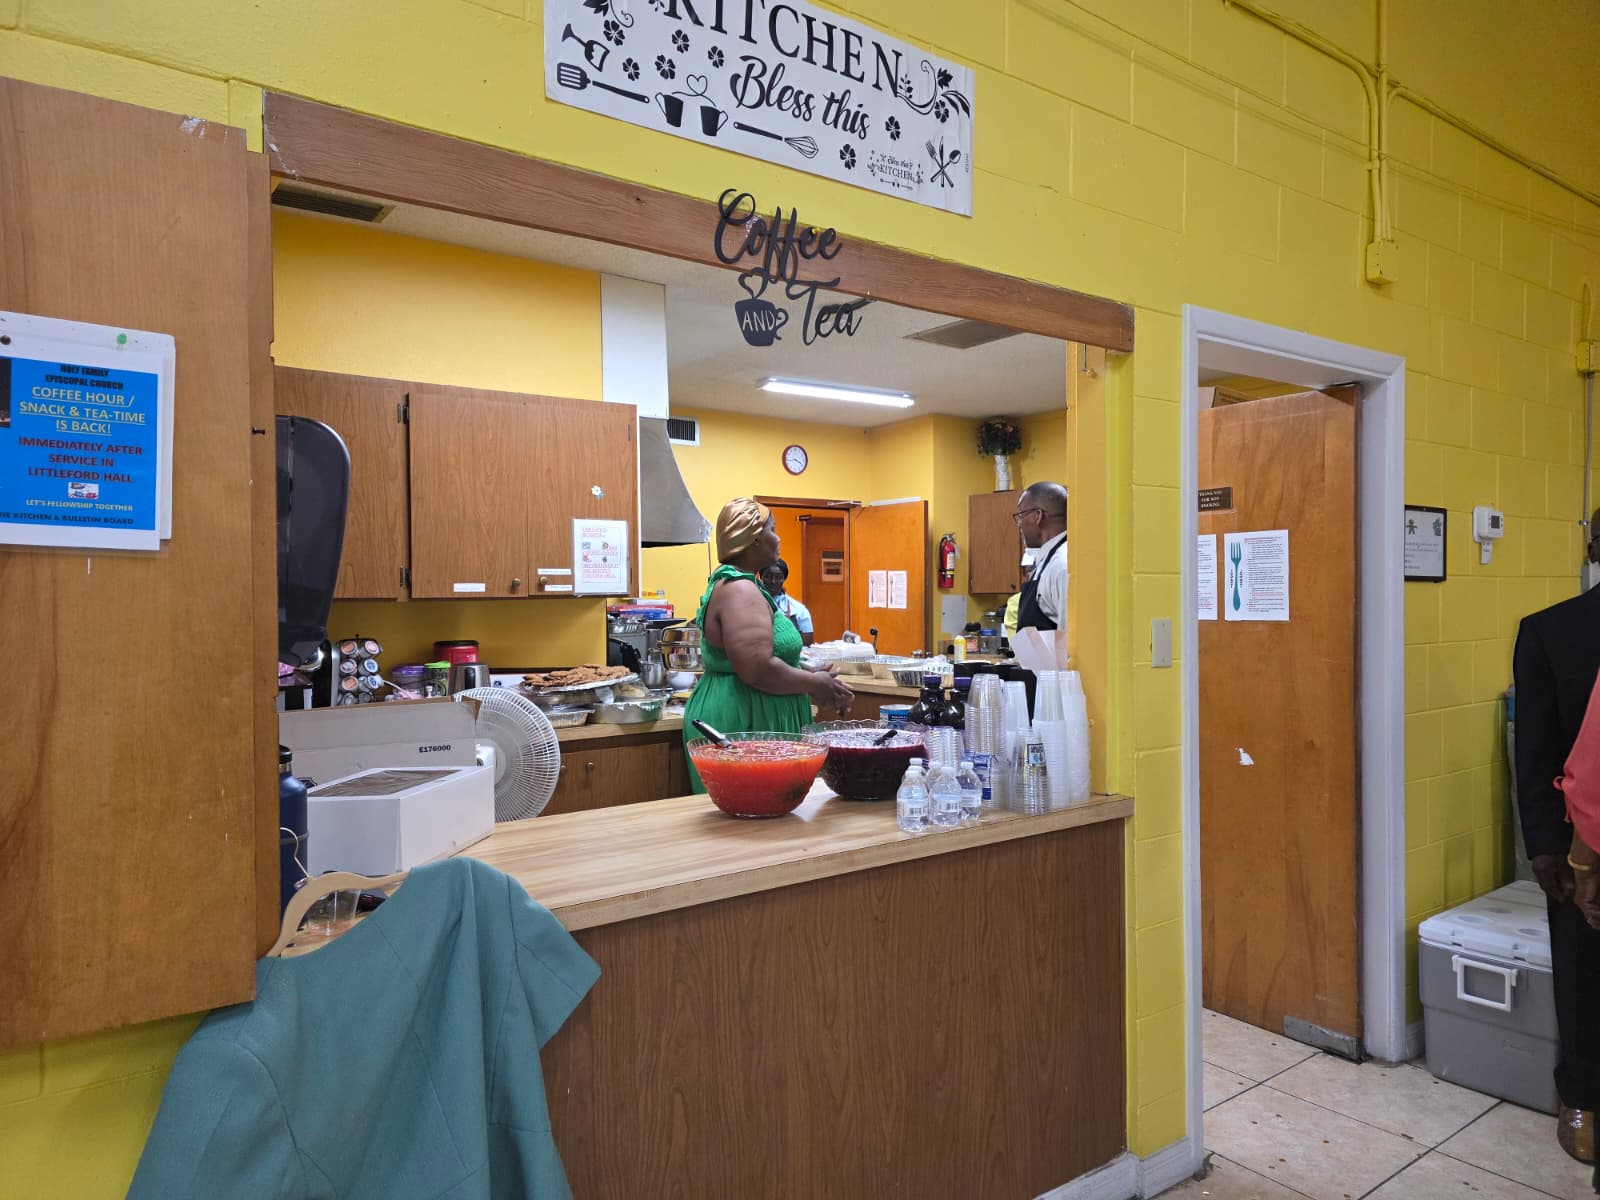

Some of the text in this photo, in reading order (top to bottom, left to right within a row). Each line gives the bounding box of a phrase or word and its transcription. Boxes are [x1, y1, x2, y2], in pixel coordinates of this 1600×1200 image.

[729, 55, 870, 140] Bless this
[714, 188, 842, 284] Coffee
[742, 311, 776, 332] AND
[785, 276, 863, 346] Tea
[32, 386, 136, 407] COFFEE HOUR /
[19, 401, 145, 423] SNACK & TEA-TIME
[56, 419, 111, 434] IS BACK!
[19, 437, 143, 455] IMMEDIATELY AFTER
[48, 454, 114, 467] SERVICE IN
[28, 467, 133, 483] LITTLEFORD HALL
[26, 499, 133, 511] LET'S FELLOWSHIP TOGETHER
